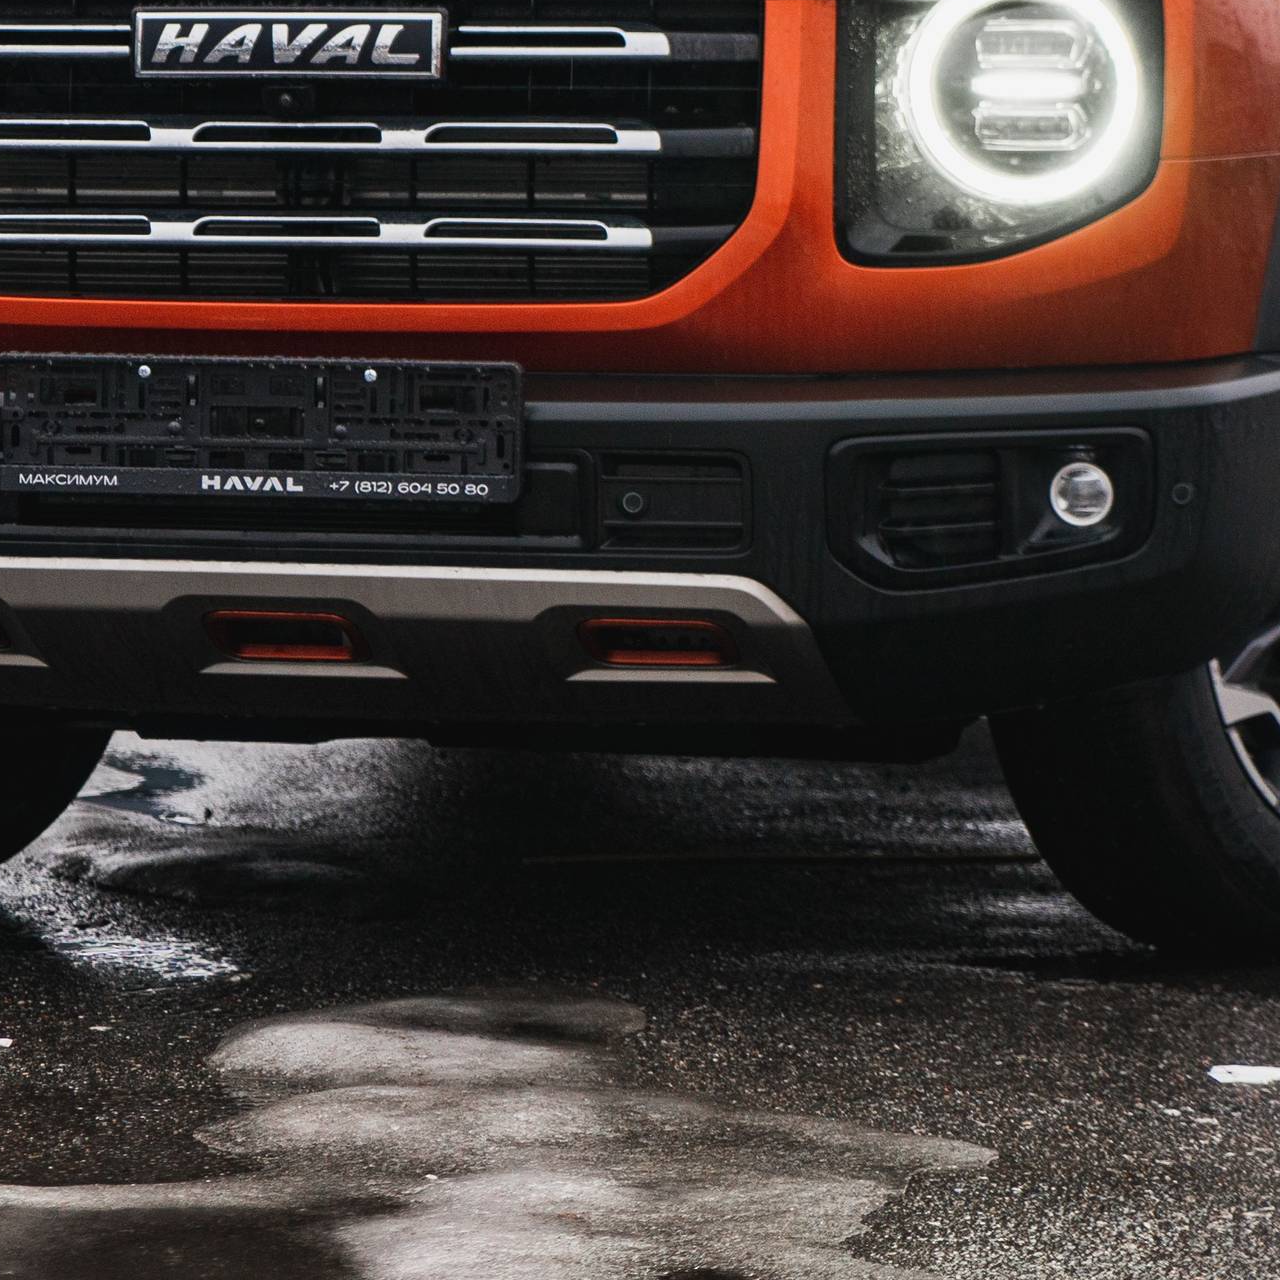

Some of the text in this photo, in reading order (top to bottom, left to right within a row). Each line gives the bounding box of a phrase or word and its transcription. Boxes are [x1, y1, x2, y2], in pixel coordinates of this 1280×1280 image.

[151, 22, 421, 65] HAVAL
[18, 473, 119, 487] МАКСИМУМ
[201, 474, 304, 492] HAVAL
[329, 480, 489, 496] +7 (812) 604 50 80
